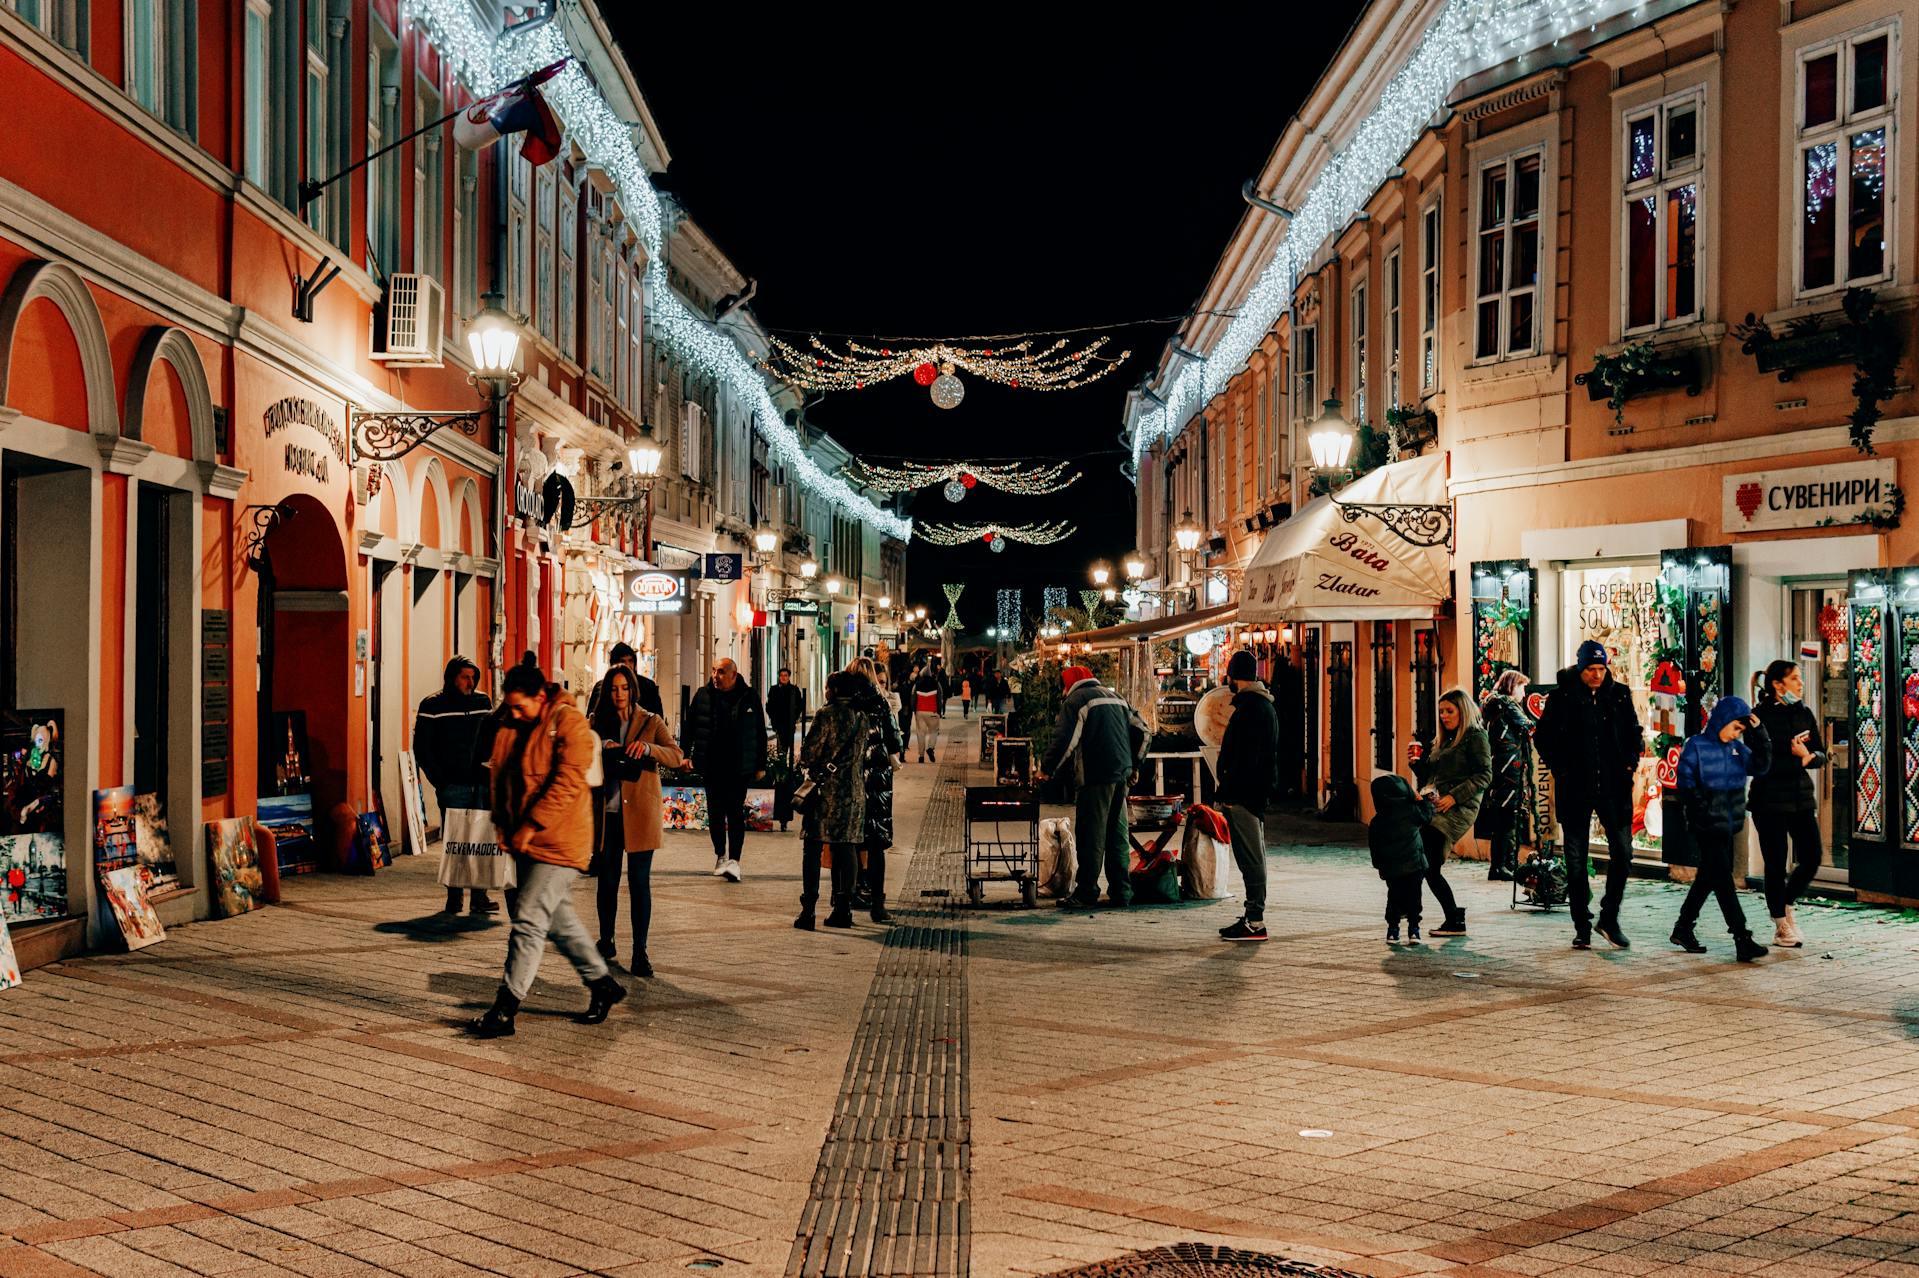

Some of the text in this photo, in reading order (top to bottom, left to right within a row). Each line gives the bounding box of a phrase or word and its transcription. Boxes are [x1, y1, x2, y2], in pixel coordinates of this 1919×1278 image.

[1768, 478, 1880, 512] СУВЕНИРИ
[1330, 532, 1390, 572] Bata
[1313, 573, 1381, 598] Zlatar
